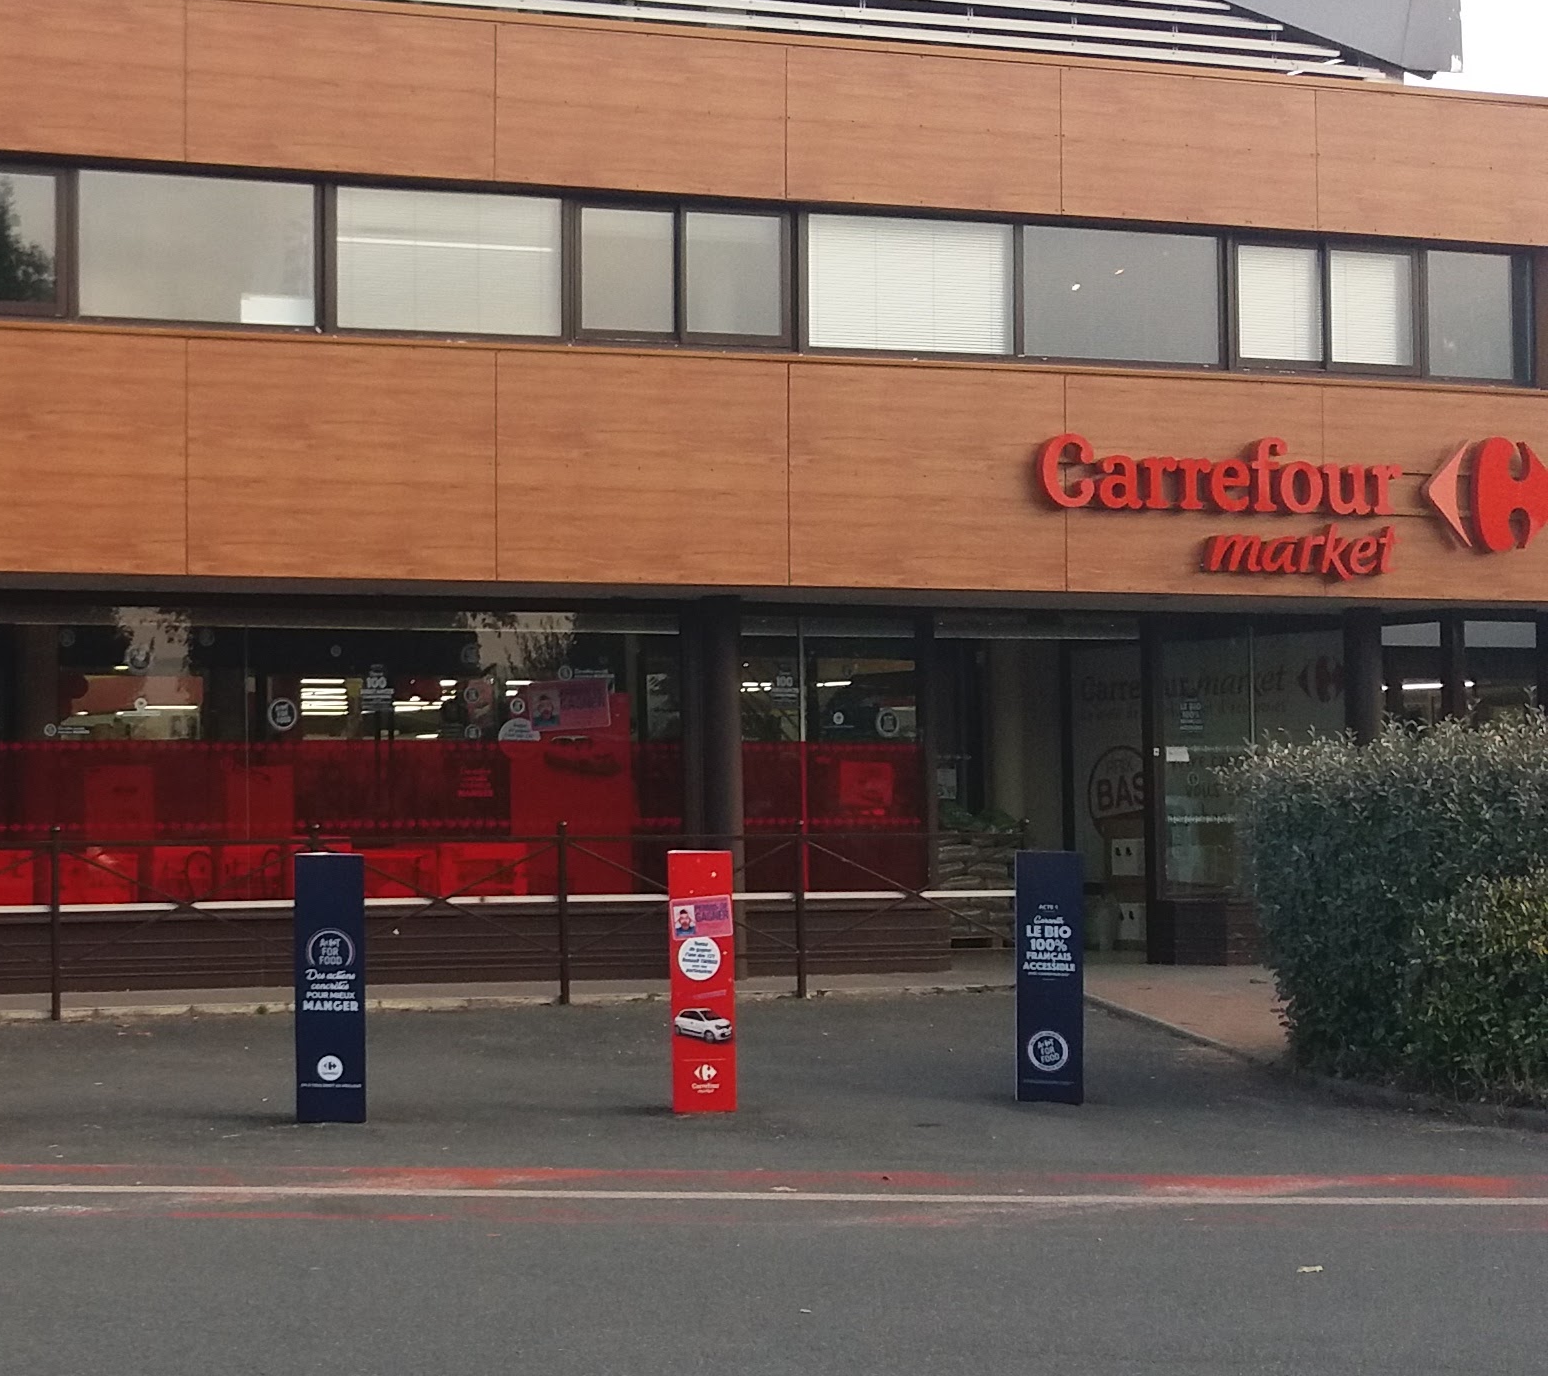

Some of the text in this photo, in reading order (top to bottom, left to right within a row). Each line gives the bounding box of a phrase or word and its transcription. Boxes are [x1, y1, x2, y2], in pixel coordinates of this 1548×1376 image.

[1038, 432, 1402, 516] Carrefour
[1205, 523, 1402, 581] market
[1026, 925, 1072, 939] LE BIO
[321, 946, 339, 956] FOR
[1030, 938, 1068, 952] 100%
[318, 955, 343, 966] FOOD
[304, 968, 356, 981] Des actions
[305, 991, 356, 1000] POUR MIEUX
[302, 1000, 359, 1012] MANGER
